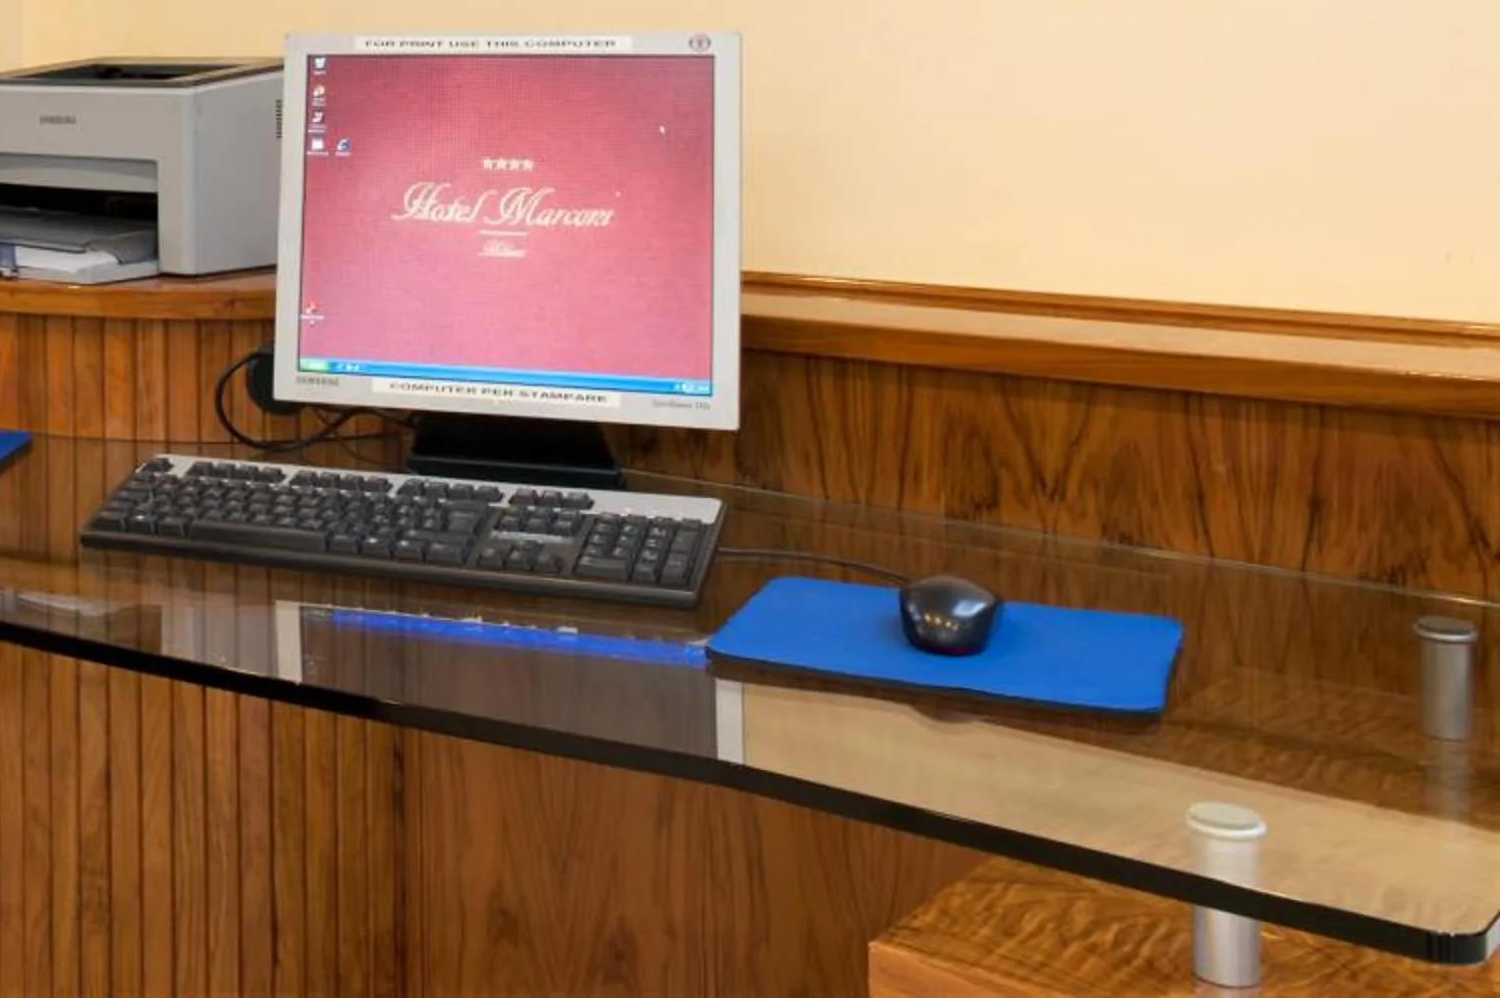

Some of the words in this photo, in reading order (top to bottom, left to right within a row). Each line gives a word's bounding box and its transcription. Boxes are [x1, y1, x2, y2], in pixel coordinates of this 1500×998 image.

[524, 39, 616, 48] COMPUTER
[390, 181, 498, 223] Hotel
[389, 383, 477, 395] COMPUTER
